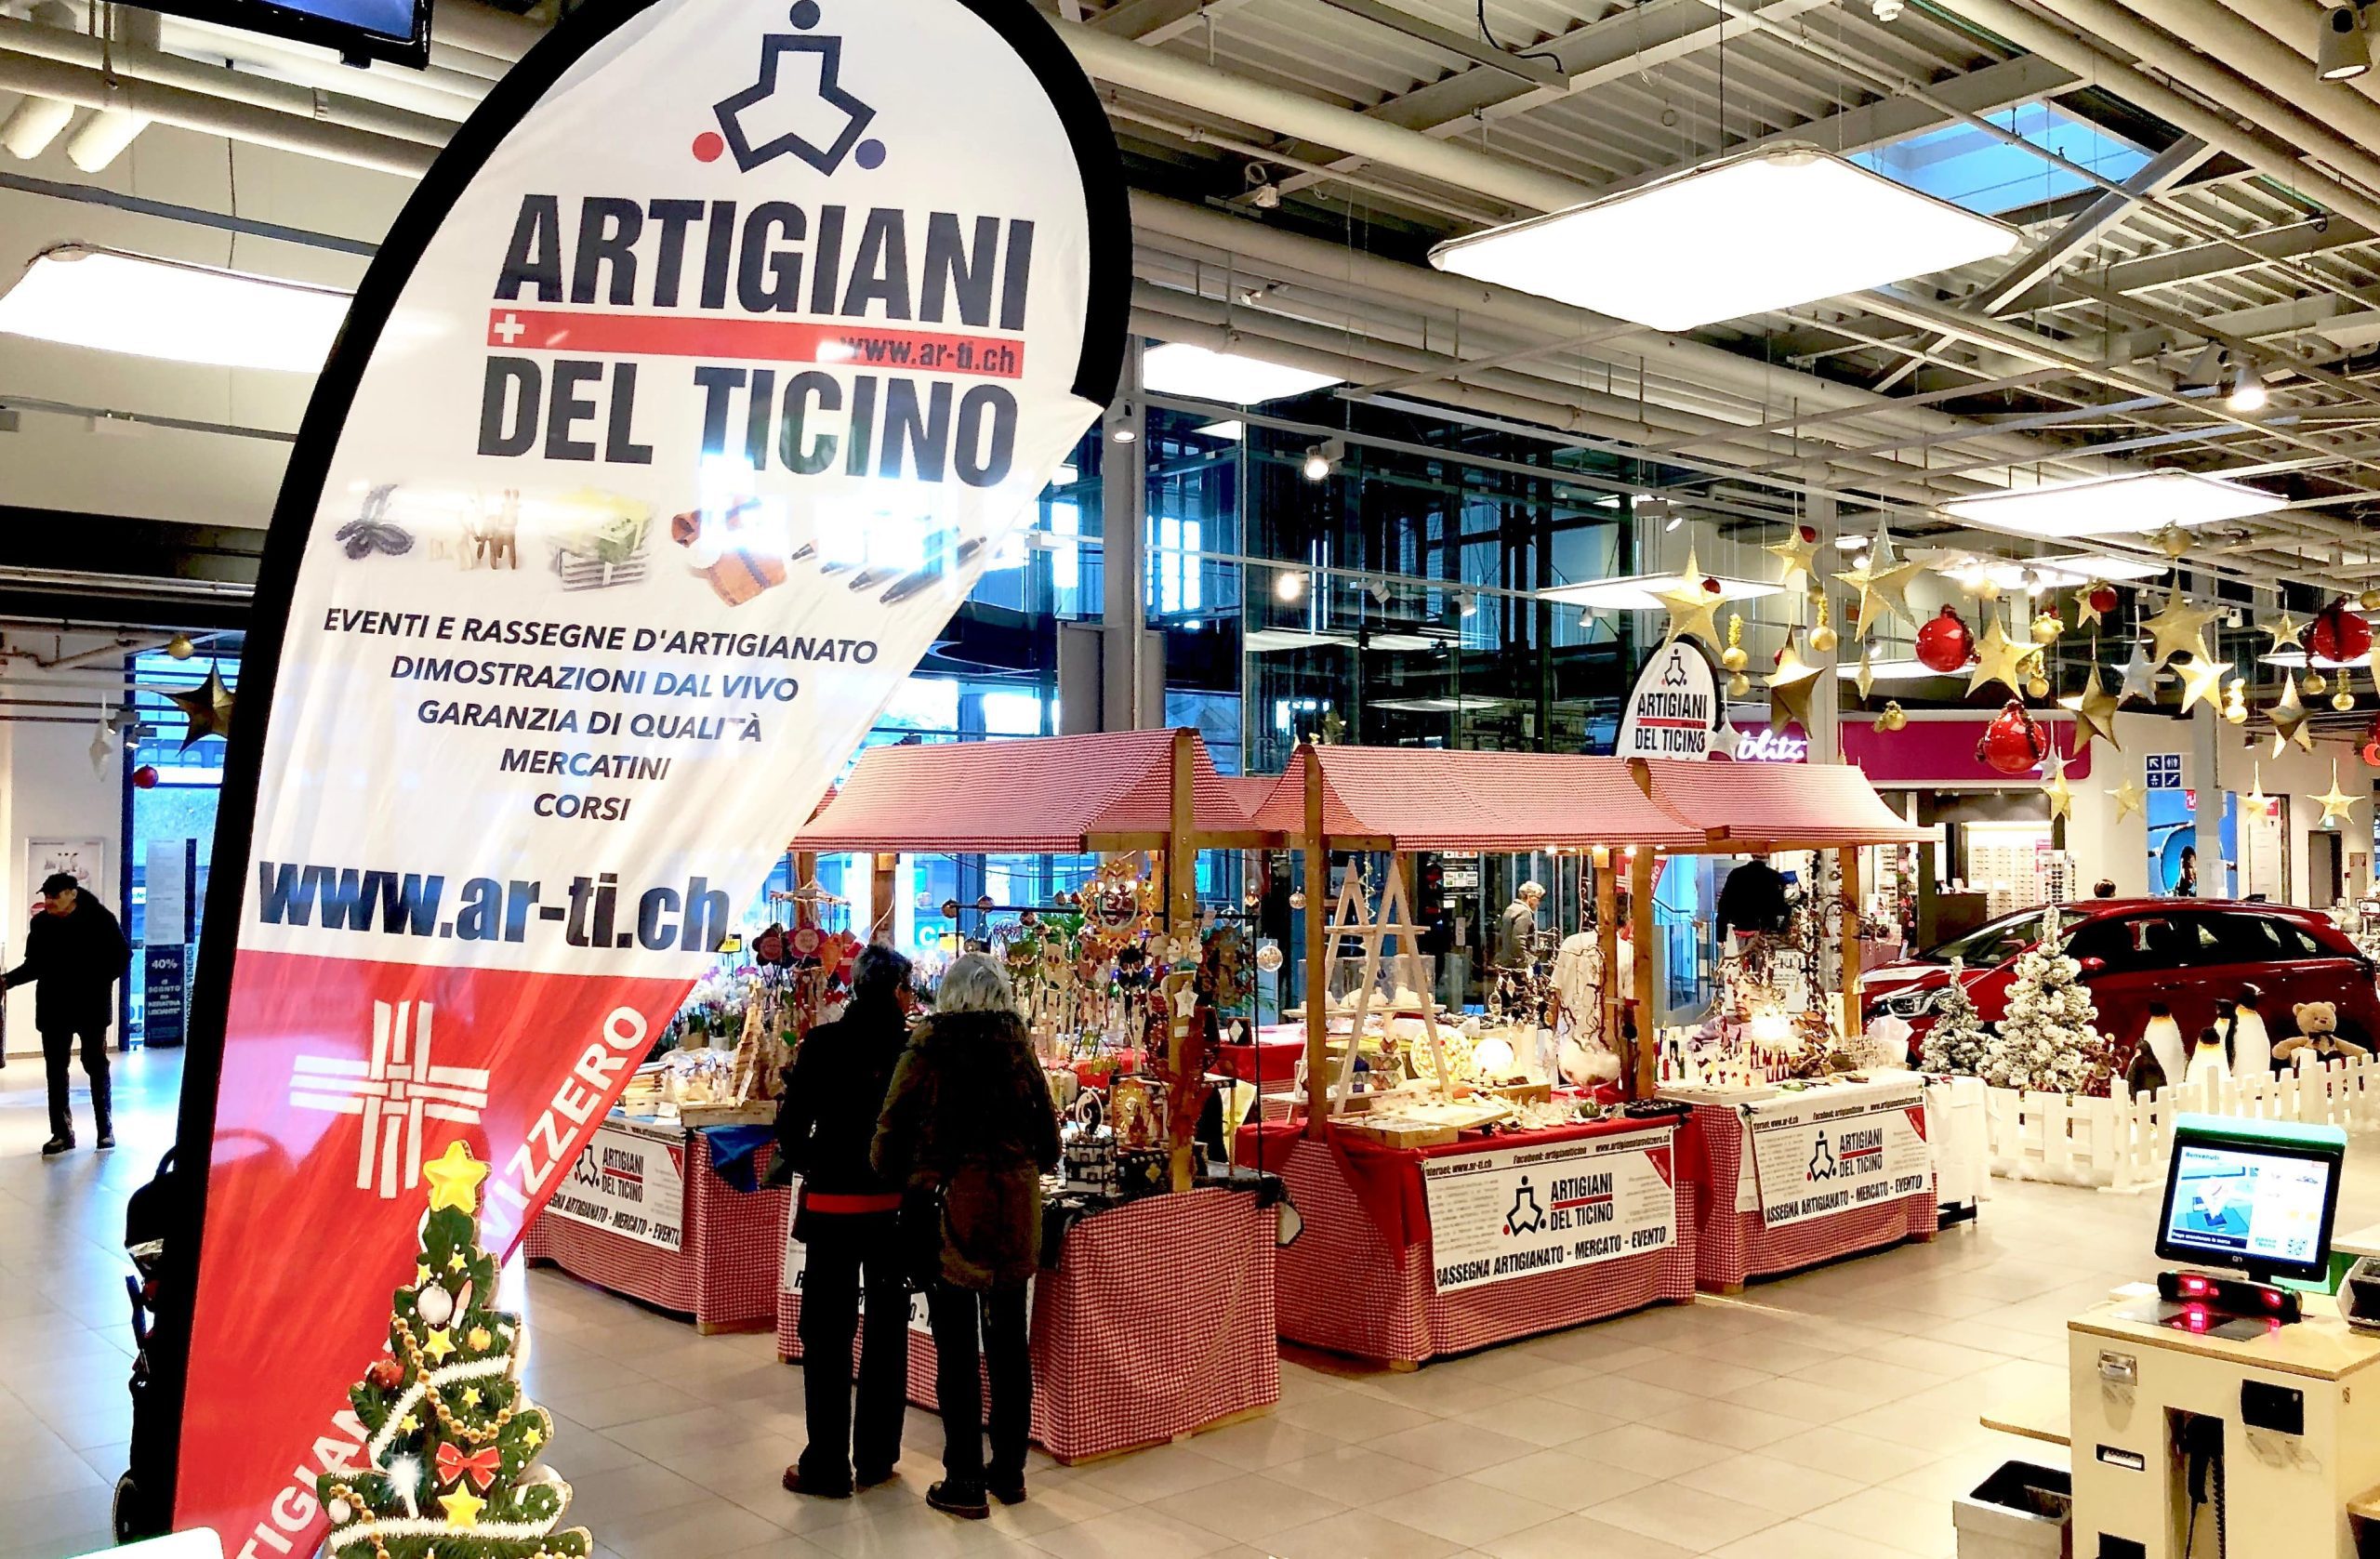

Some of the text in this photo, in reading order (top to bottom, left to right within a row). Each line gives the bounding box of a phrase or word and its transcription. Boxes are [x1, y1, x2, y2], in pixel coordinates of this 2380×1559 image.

[493, 193, 1035, 331] ARTIGIANI
[478, 356, 1018, 488] DEL TICINO
[324, 608, 878, 664] EVENTI E RASSEGNE D'ARTIGIANATO
[390, 655, 799, 702] DIMOSTRAZIONI DAL VIVO
[418, 700, 577, 733] GARANZIA
[588, 712, 621, 734] DI
[1636, 693, 1707, 720] ARTIGIANI
[1635, 728, 1705, 753] DEL TICINO
[500, 748, 671, 780] MERCATINI
[534, 793, 629, 821] CORSI
[258, 861, 730, 952] www.ar-ti.ch
[152, 958, 178, 970] 40%
[480, 1006, 648, 1239] VIZZERO
[1839, 1128, 1883, 1153] ARTIGIANI
[602, 1146, 643, 1175] ARTIGIANI
[1840, 1154, 1883, 1178] DEL TICINO
[602, 1175, 615, 1196] DEL
[618, 1179, 643, 1203] TICINO
[1551, 1172, 1612, 1202] ARTIGIANI
[1765, 1201, 1799, 1222] ASSEGNA
[1802, 1190, 1849, 1215] ARTIGIANATO
[1857, 1181, 1888, 1202] MERCATO
[1896, 1174, 1923, 1193] EVENTO
[564, 1196, 608, 1223] ARTIGIANATO
[612, 1210, 647, 1235] MERCATO
[1551, 1202, 1613, 1231] DEL TICINO
[1436, 1259, 1490, 1287] RASSEGNA
[1493, 1245, 1564, 1275] ARTIGIANATO
[1575, 1235, 1621, 1260] MERCATO
[1632, 1226, 1666, 1249] EVENTO
